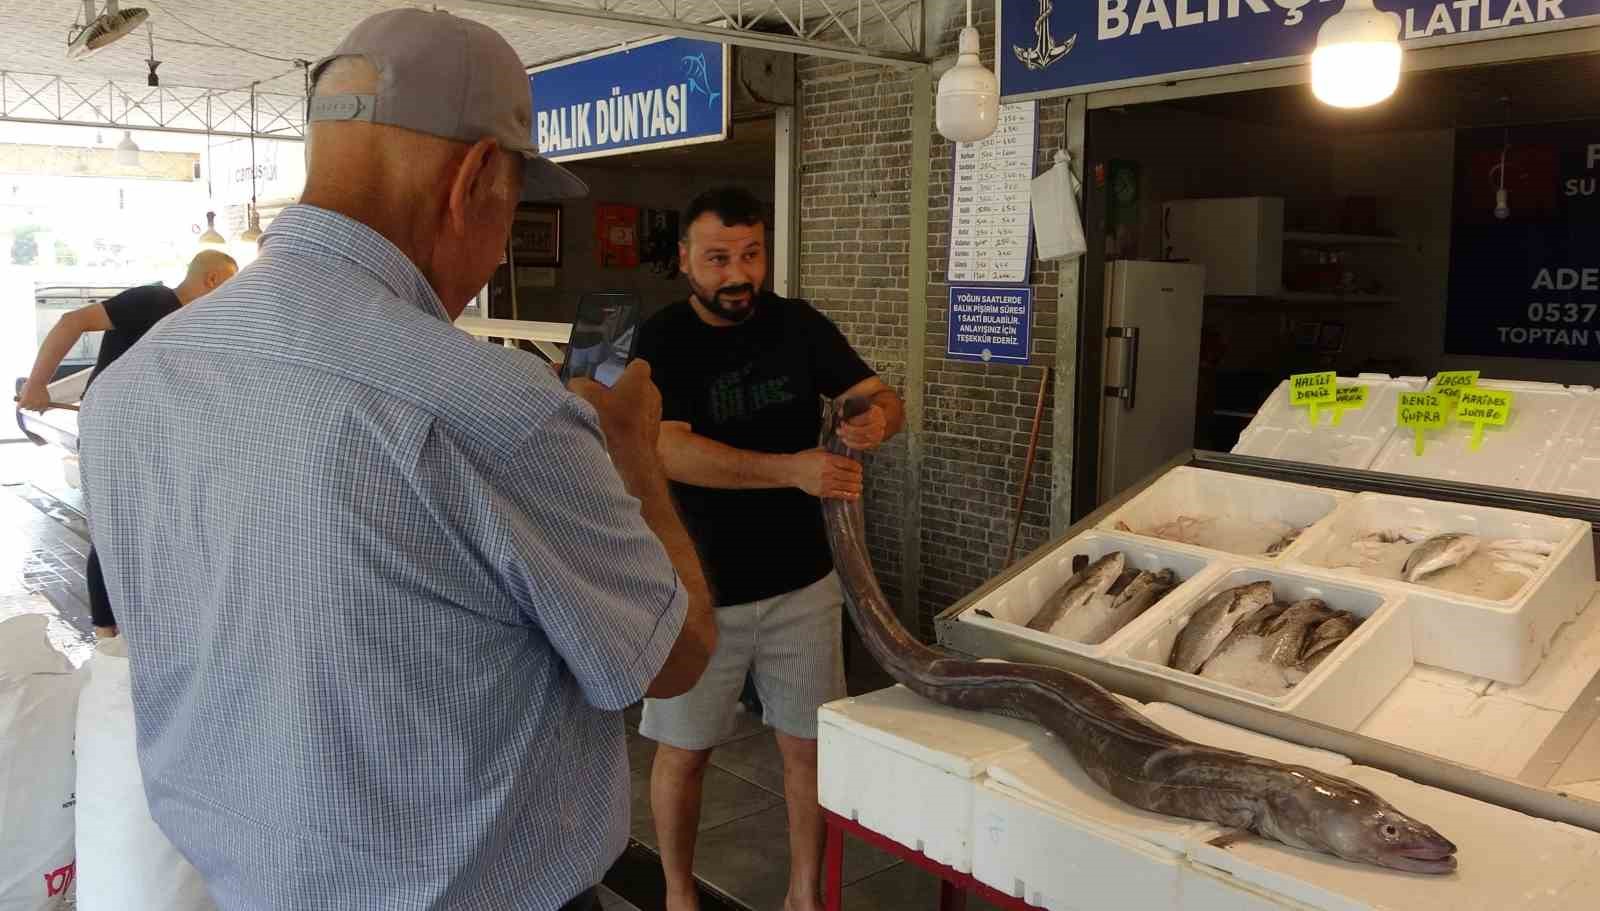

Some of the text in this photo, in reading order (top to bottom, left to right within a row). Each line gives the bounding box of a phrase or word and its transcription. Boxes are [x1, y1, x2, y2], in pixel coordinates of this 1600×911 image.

[1097, 0, 1566, 40] BALI LATLAR
[537, 83, 688, 153] BALIK DÜNYASI
[1565, 178, 1595, 196] SU
[957, 294, 1022, 304] YOĞUN SAATLERDE
[953, 304, 972, 313] BALIK
[999, 306, 1025, 314] SÜRESİ
[962, 314, 982, 323] SAATİ
[1002, 325, 1016, 335] İÇİN
[956, 334, 991, 344] TEŞEKKÜR
[1497, 327, 1588, 346] TOPTAN
